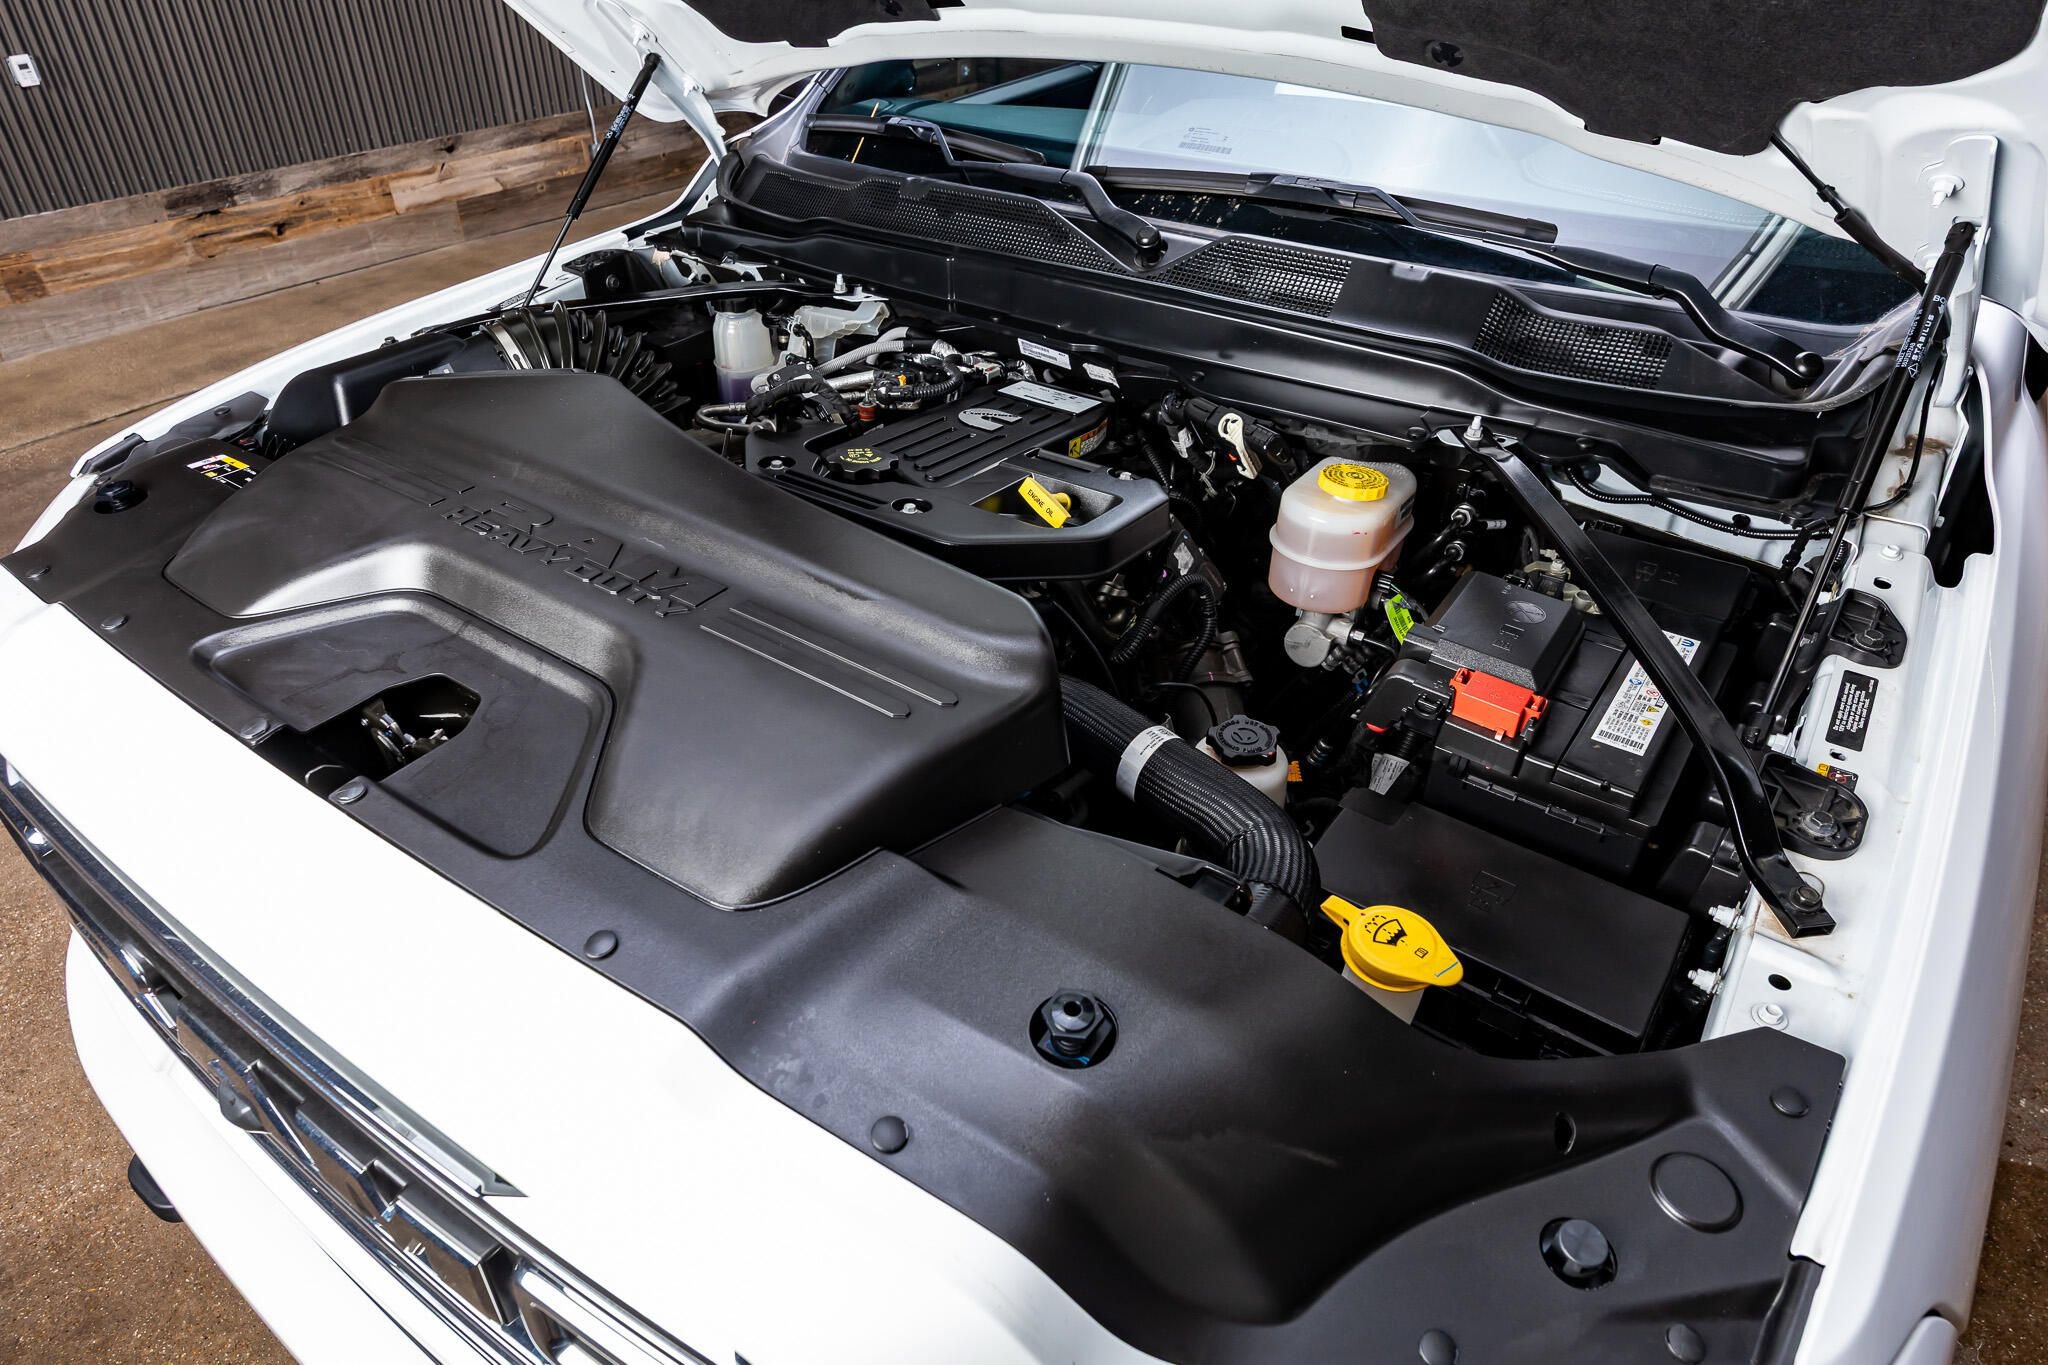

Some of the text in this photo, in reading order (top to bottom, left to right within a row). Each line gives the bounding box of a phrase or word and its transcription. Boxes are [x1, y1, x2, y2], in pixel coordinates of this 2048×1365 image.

[1912, 314, 1934, 360] STABILUS
[1027, 488, 1055, 519] ENGINE OIL
[441, 507, 691, 618] HEAVY DUTY
[462, 500, 729, 608] RAM
